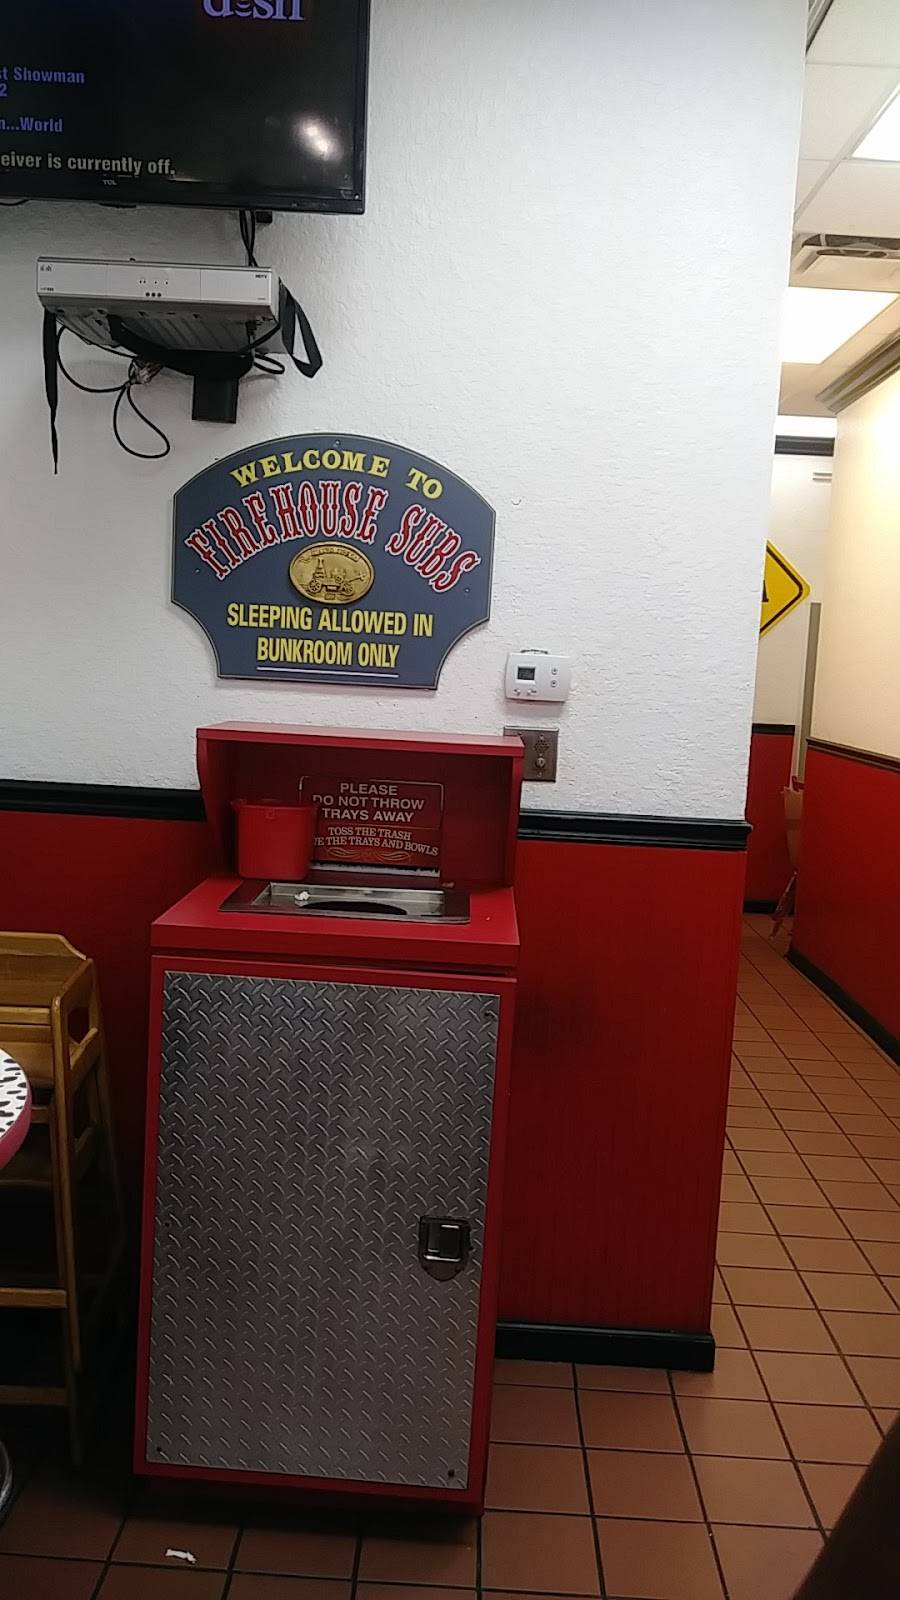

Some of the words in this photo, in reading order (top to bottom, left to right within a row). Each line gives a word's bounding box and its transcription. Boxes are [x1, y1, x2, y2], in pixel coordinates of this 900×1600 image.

[14, 66, 85, 84] Showman
[1, 151, 42, 168] eiver
[48, 153, 62, 169] is
[68, 156, 142, 175] currently
[148, 159, 176, 175] off.
[230, 449, 391, 487] WELCOME
[405, 468, 443, 500] TO
[184, 480, 389, 580] FIREHOUSE
[386, 503, 481, 593] SUBS
[227, 603, 312, 631] SLEEPING
[318, 608, 406, 636] ALLOWED
[413, 613, 433, 637] IN
[257, 637, 352, 666] BUNKROOM
[358, 643, 400, 668] ONLY
[340, 782, 398, 796] PLEASE
[313, 795, 334, 806] DO
[338, 796, 368, 808] NOT
[371, 798, 424, 810] THROW
[322, 808, 369, 821] TRAYS
[373, 811, 415, 823] AWAY
[328, 827, 353, 836] TOSS
[355, 827, 376, 837] THE
[378, 829, 412, 841] TRASH
[326, 837, 347, 846] THE
[349, 837, 381, 847] TRAYS
[382, 839, 403, 850] AND
[404, 841, 439, 856] BOWLS
